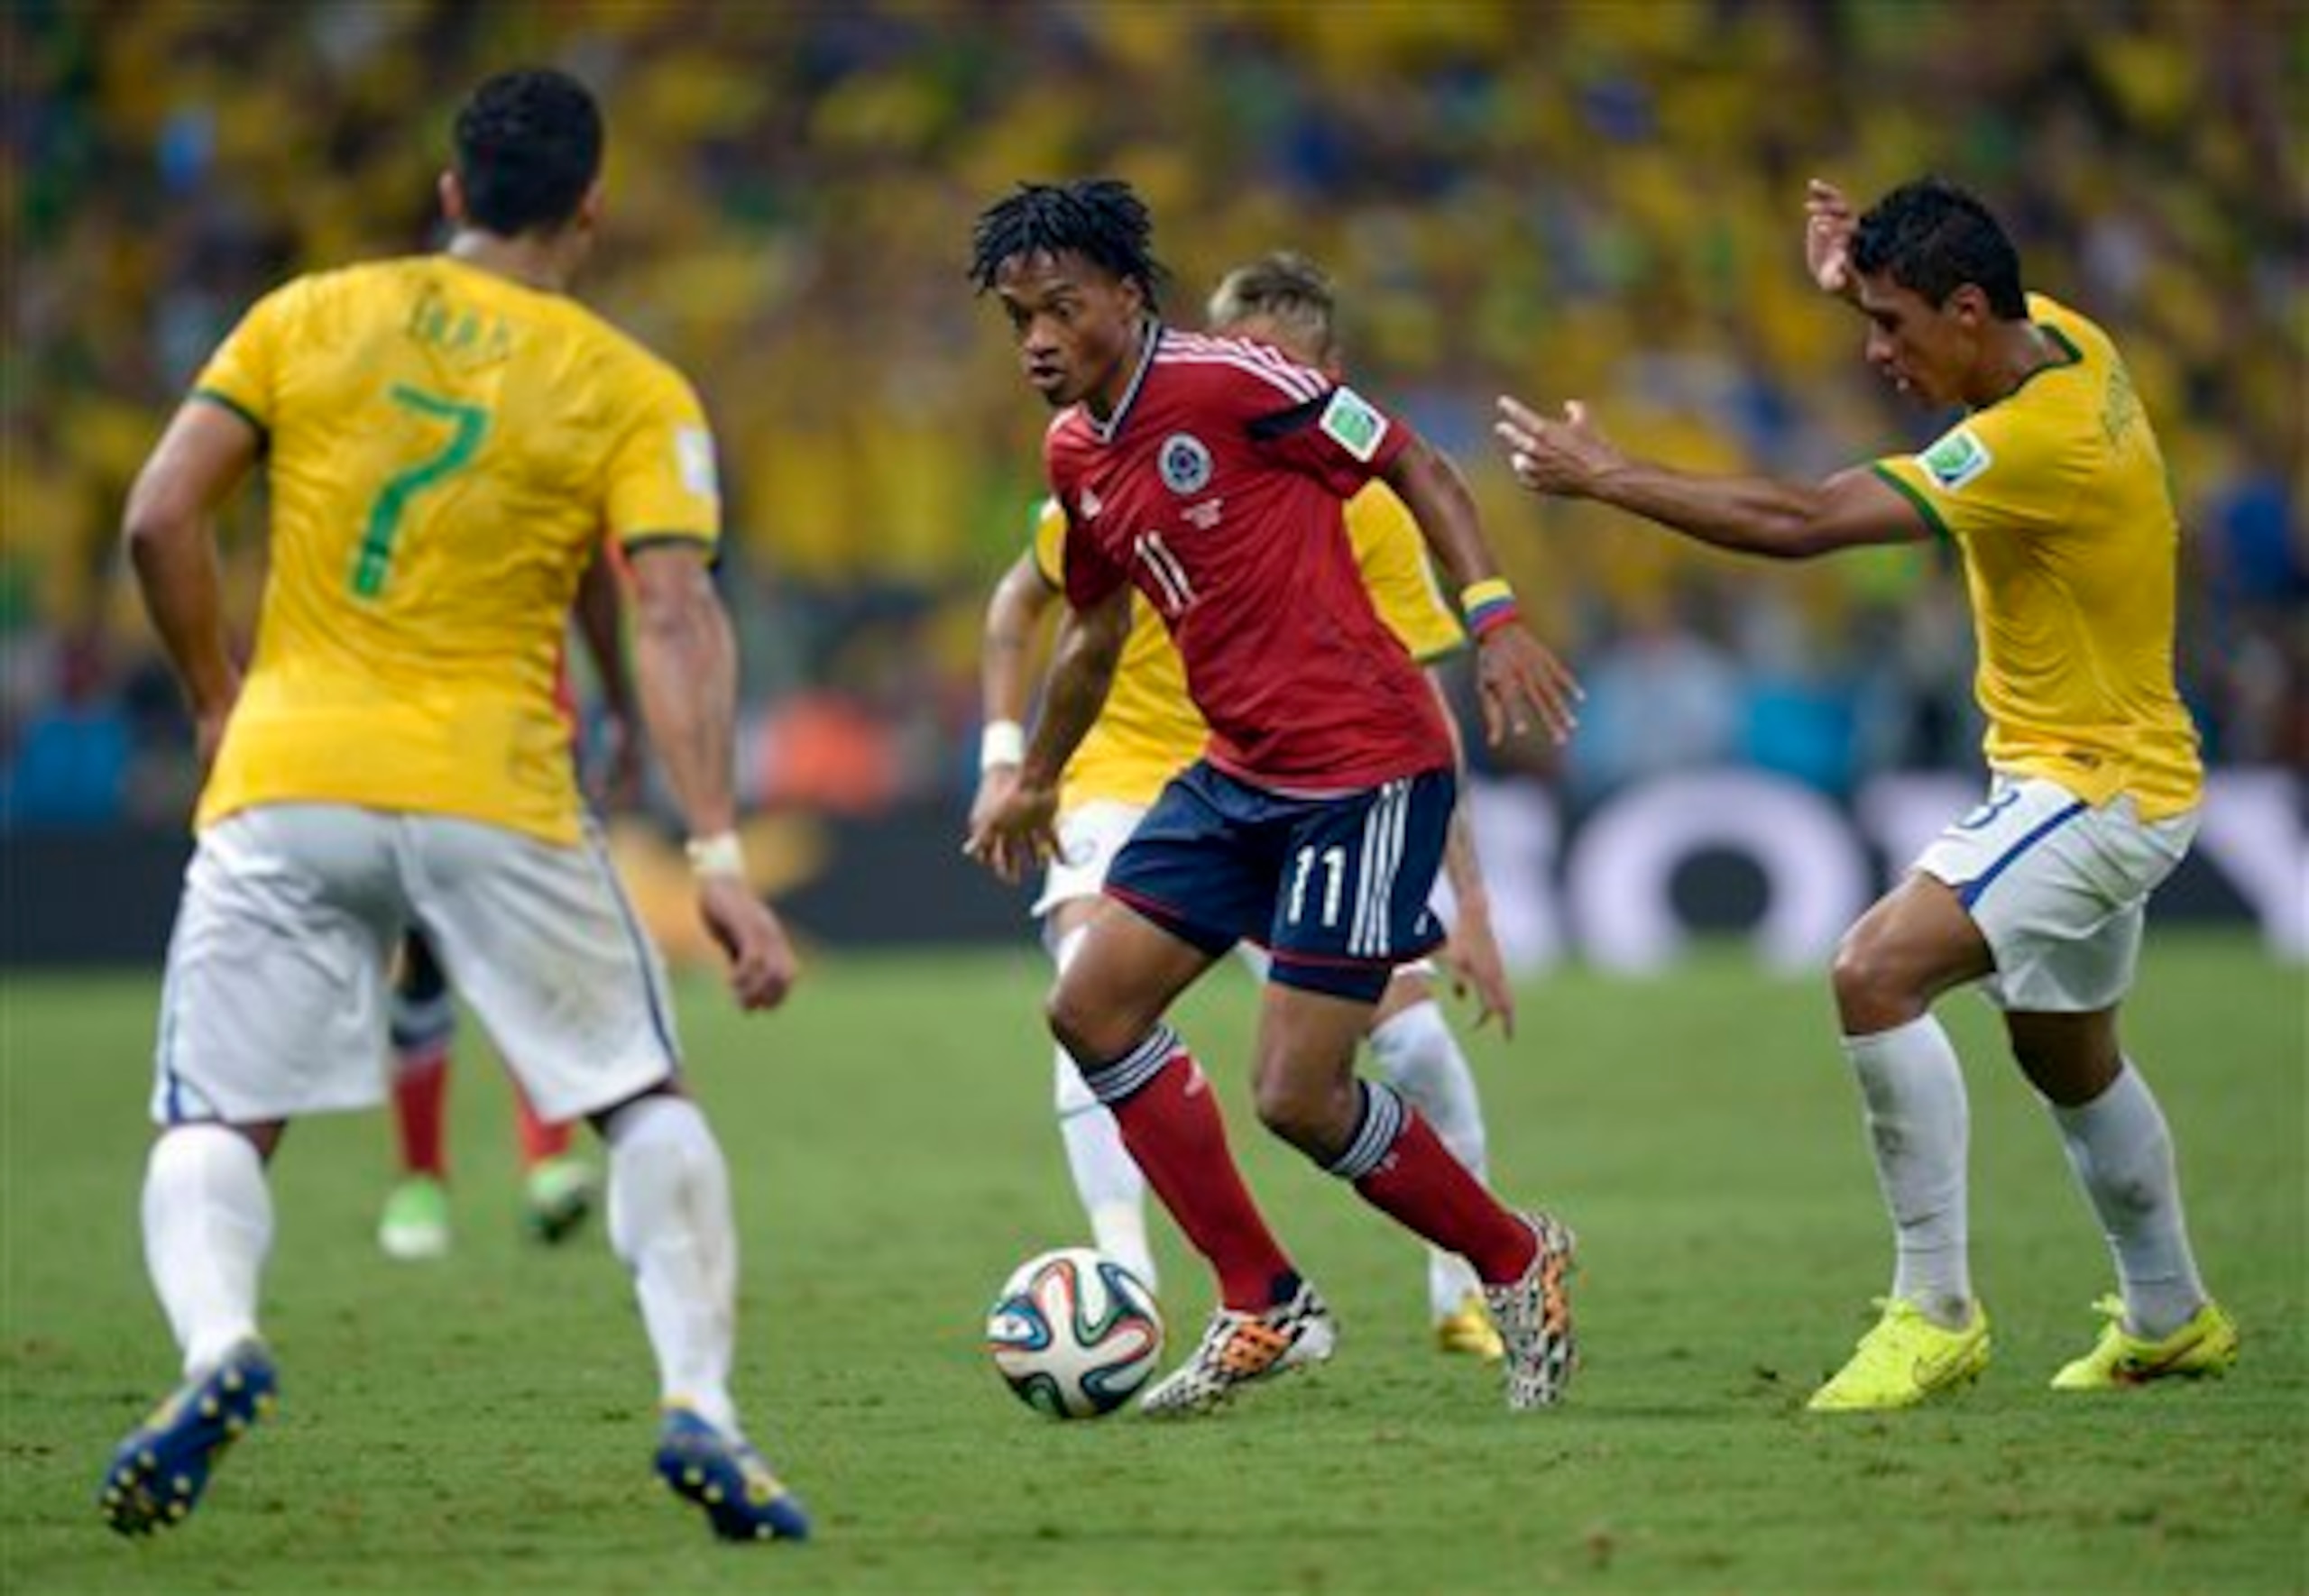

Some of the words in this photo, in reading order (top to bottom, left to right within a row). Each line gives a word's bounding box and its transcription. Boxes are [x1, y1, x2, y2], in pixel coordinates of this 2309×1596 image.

[352, 382, 489, 599] 7
[1134, 529, 1197, 619] 11
[1287, 844, 1348, 928] 11
